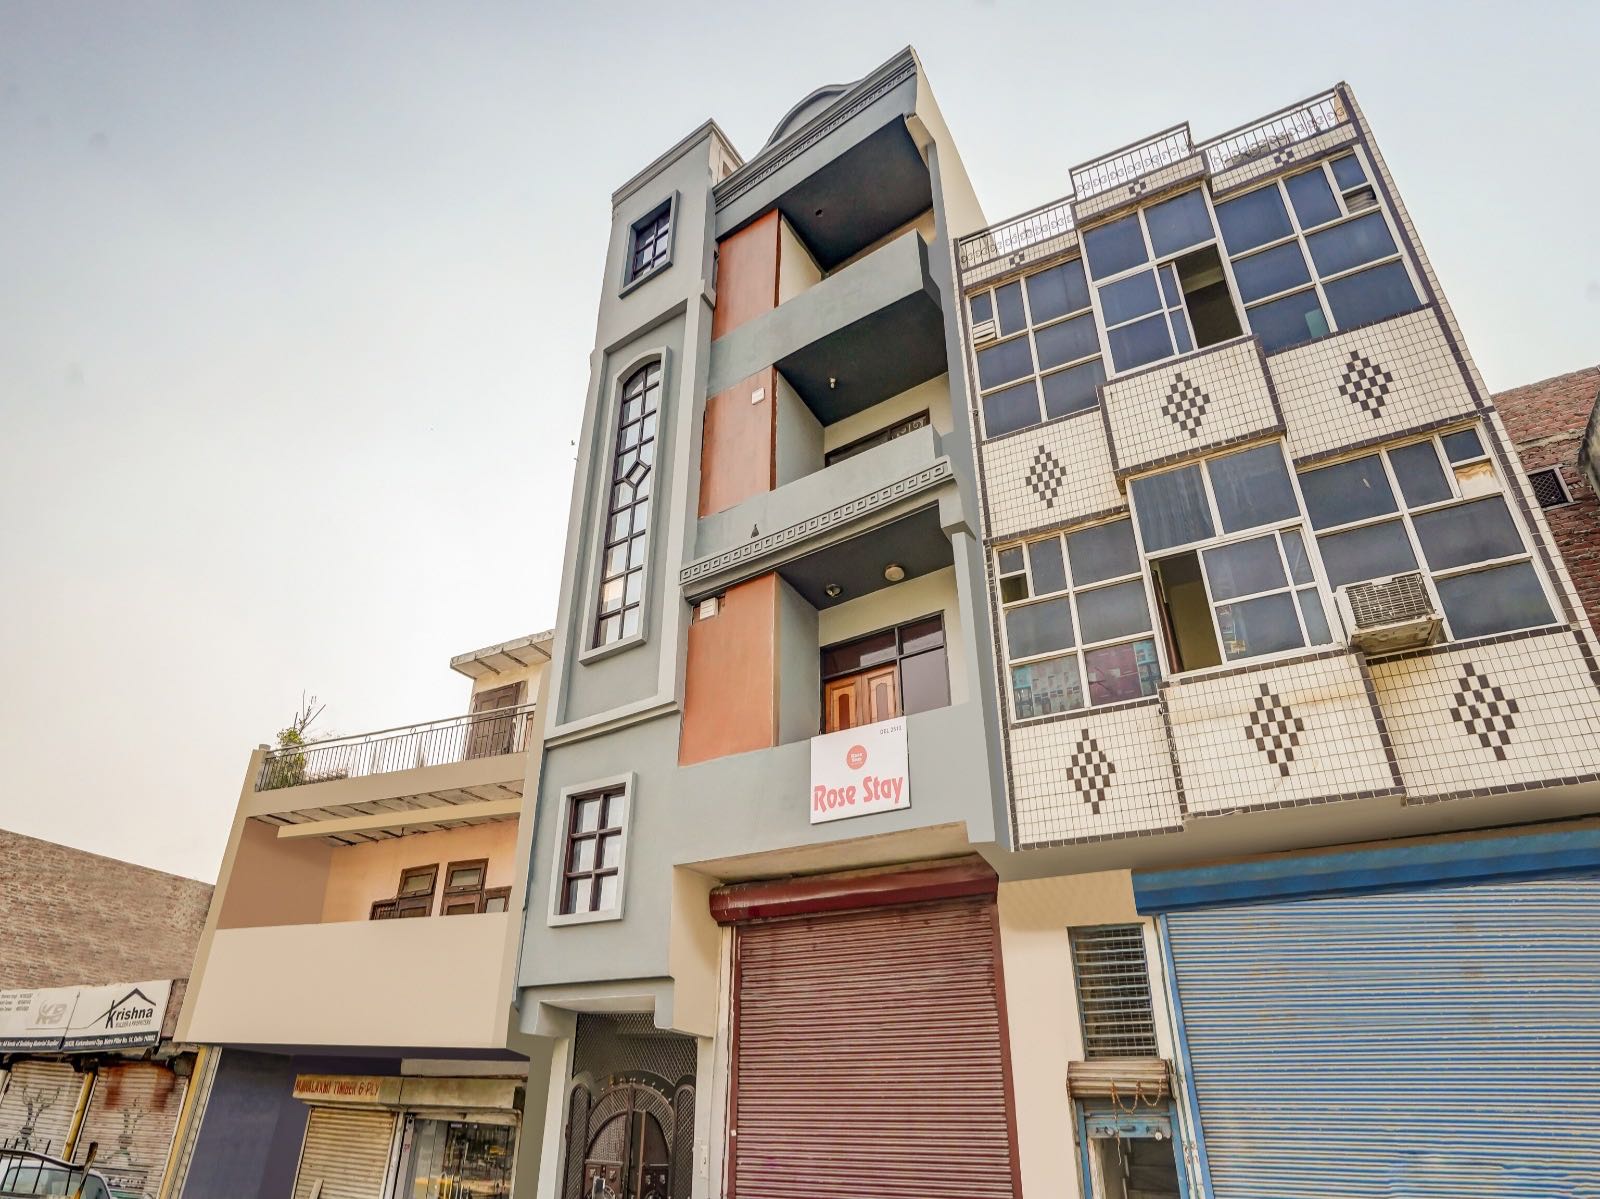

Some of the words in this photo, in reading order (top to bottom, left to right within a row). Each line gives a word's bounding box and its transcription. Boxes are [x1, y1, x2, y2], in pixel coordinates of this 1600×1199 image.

[814, 785, 856, 813] Rose
[862, 775, 903, 804] Stay
[105, 1000, 153, 1029] Krishna
